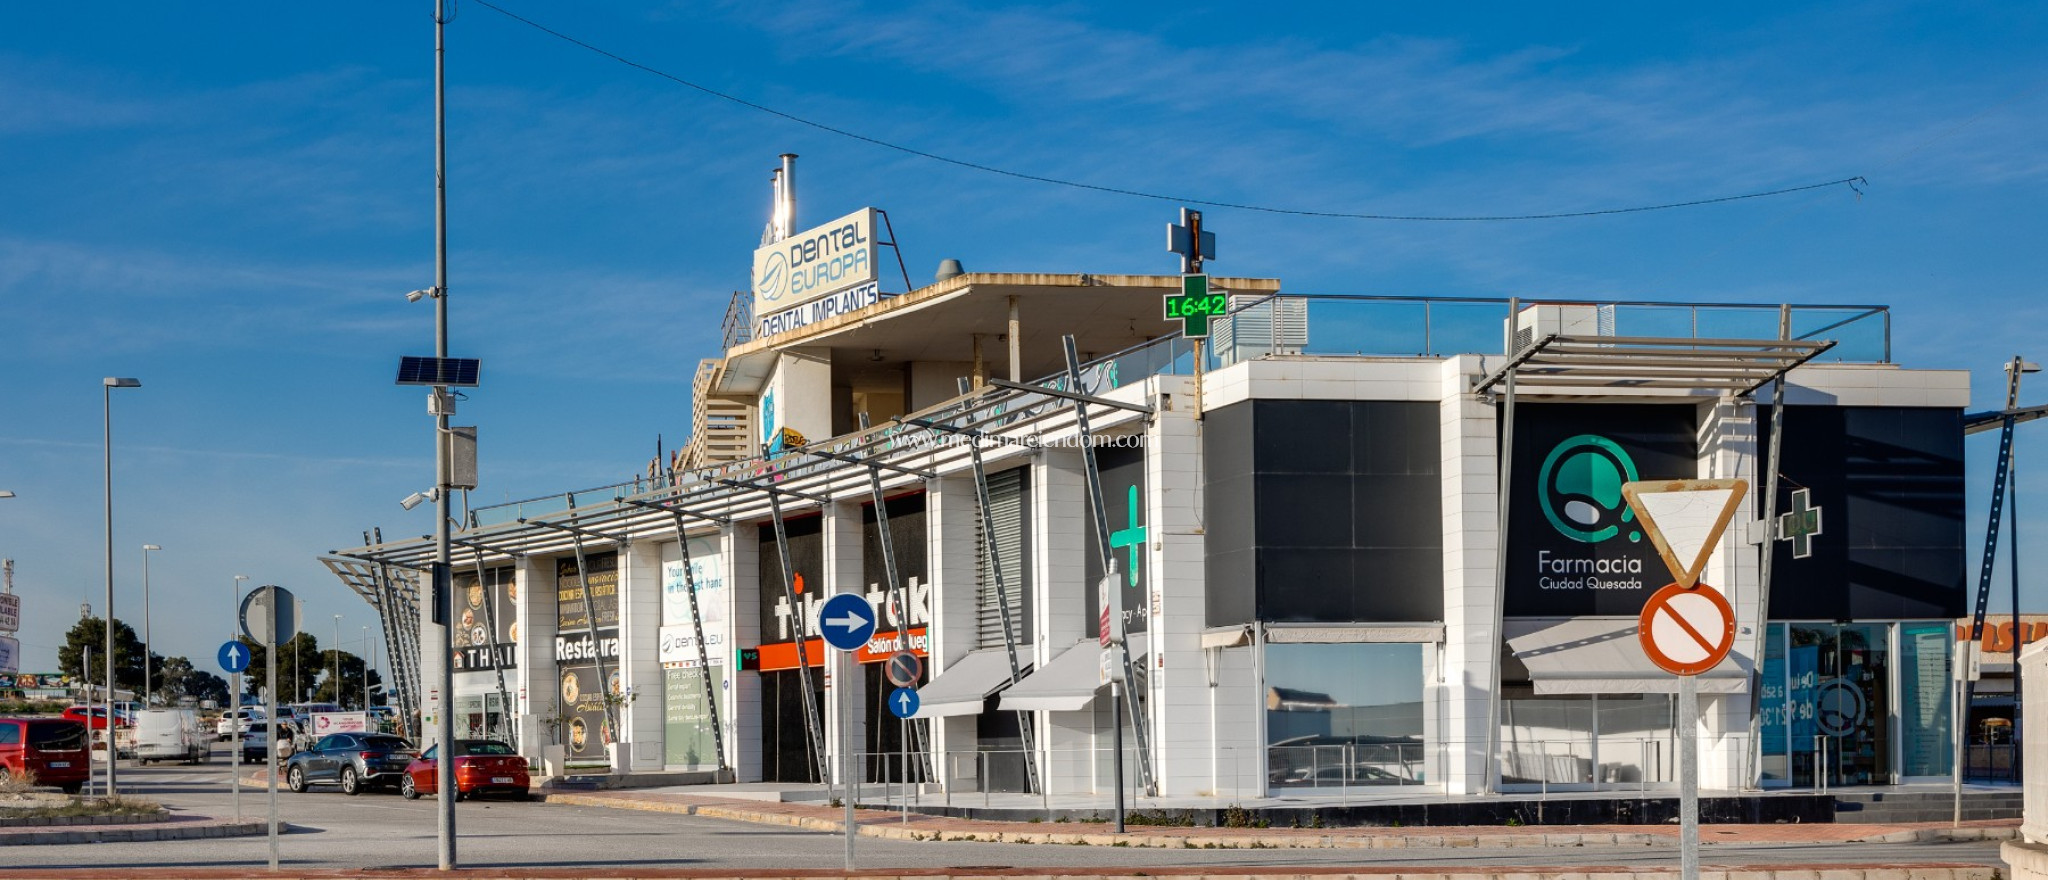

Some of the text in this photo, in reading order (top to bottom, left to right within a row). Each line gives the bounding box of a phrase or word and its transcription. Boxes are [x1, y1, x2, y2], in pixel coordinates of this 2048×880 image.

[762, 284, 876, 338] DENTAL IMPLANTS
[1167, 296, 1226, 317] 16:42
[1538, 551, 1643, 574] Farmacia
[1539, 576, 1642, 590] Ciudad Quesada
[867, 636, 892, 655] Salón
